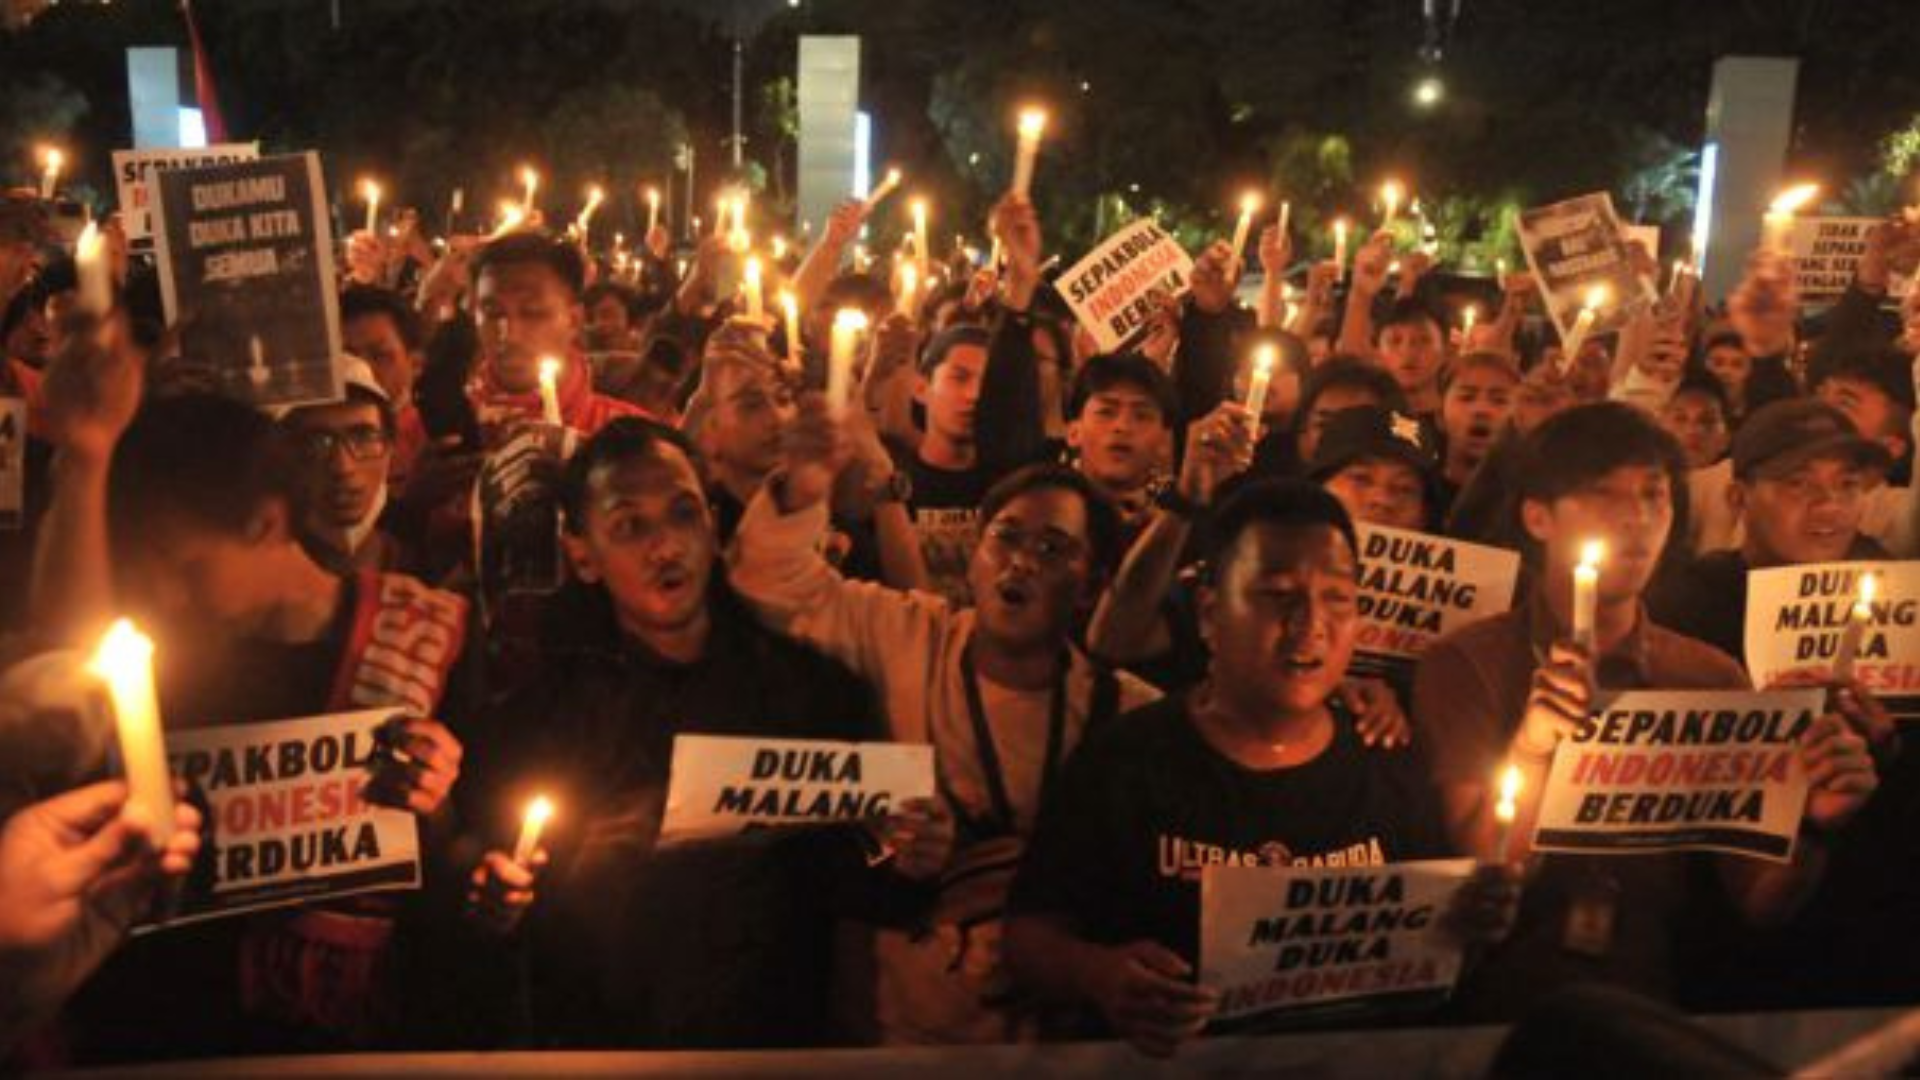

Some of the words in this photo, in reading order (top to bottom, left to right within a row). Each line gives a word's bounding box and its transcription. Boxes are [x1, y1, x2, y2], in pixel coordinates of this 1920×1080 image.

[1069, 226, 1165, 304] SEPAKBOLA
[1087, 243, 1180, 323] INDONESIA
[1365, 533, 1456, 574] DUKA
[1797, 633, 1889, 661] DUA
[1571, 710, 1814, 743] SEPAKBOLA
[751, 748, 862, 783] DUKA
[1573, 752, 1791, 785] INDONESIA
[712, 786, 890, 818] MALANG
[1575, 790, 1764, 823] BERDUKA
[1287, 876, 1404, 908] DUKA
[1248, 904, 1433, 945] MALANG
[1274, 937, 1389, 971] DUKA
